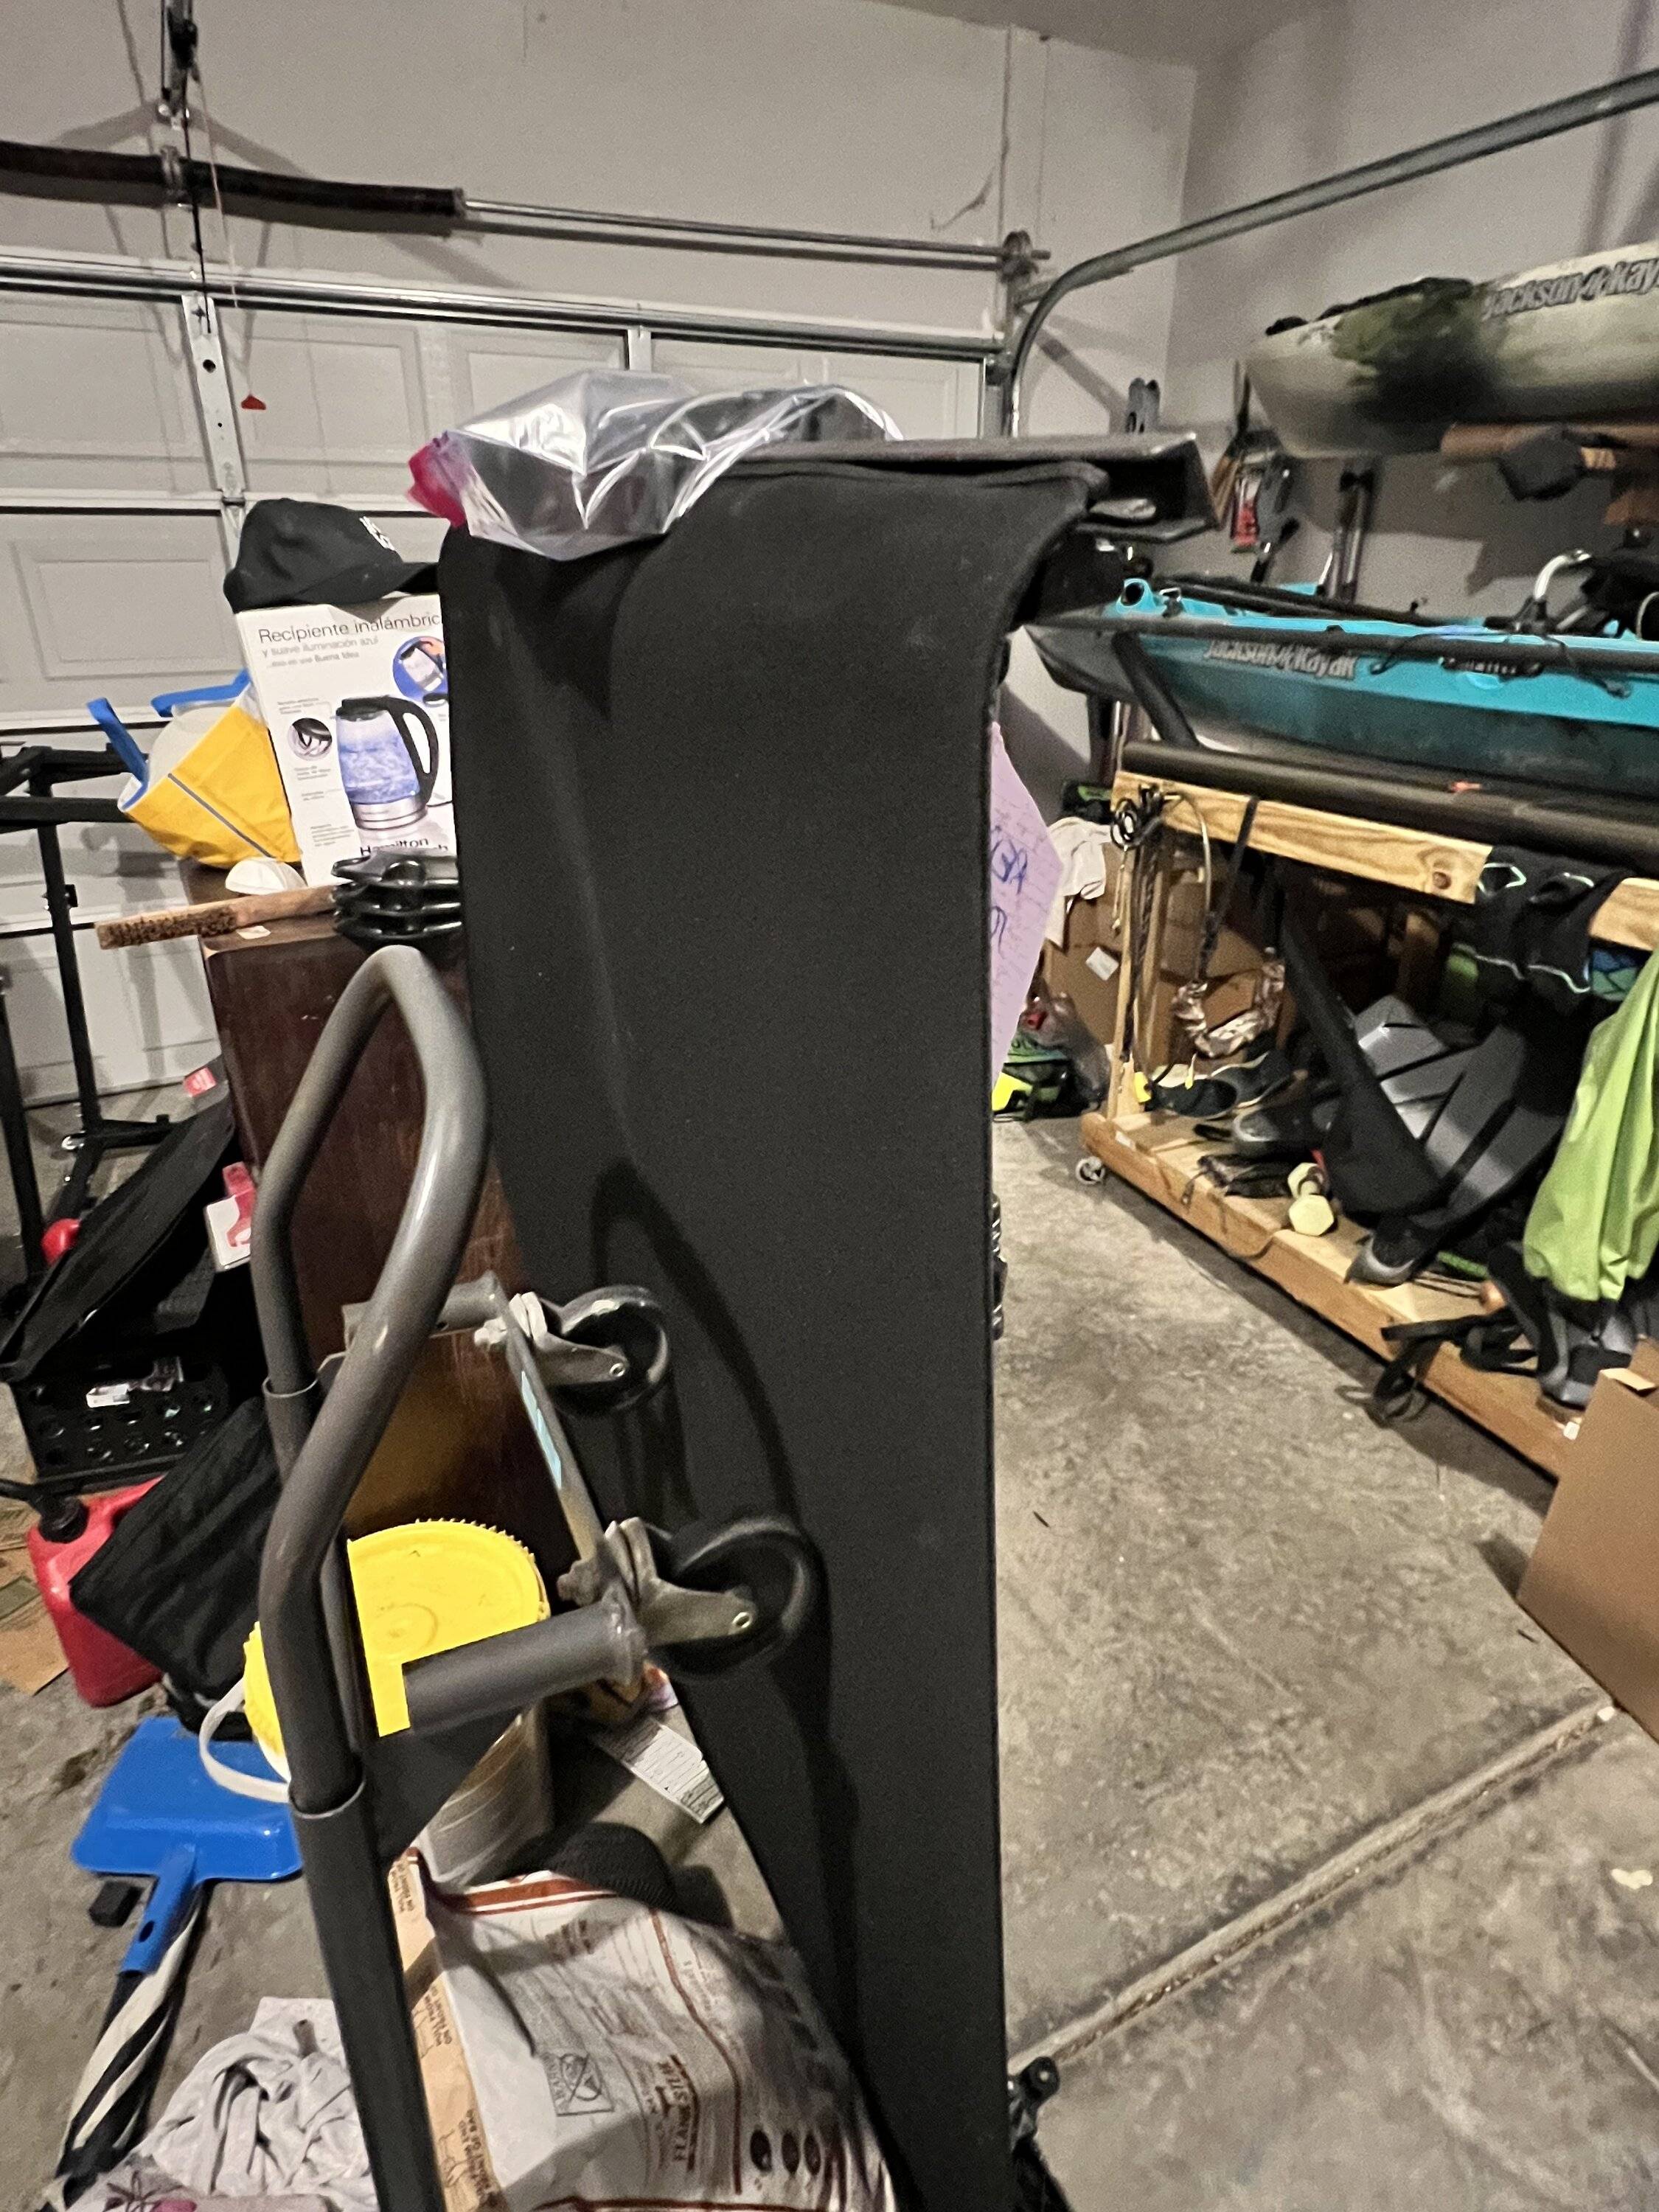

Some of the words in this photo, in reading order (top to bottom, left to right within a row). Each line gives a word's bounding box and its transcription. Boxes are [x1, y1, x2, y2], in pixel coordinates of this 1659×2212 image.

[1605, 257, 1659, 296] Kay
[258, 622, 349, 644] Recipiente
[355, 612, 442, 633] inalámbric
[271, 647, 300, 655] suave
[302, 640, 358, 651] iluminación
[360, 636, 379, 647] azul
